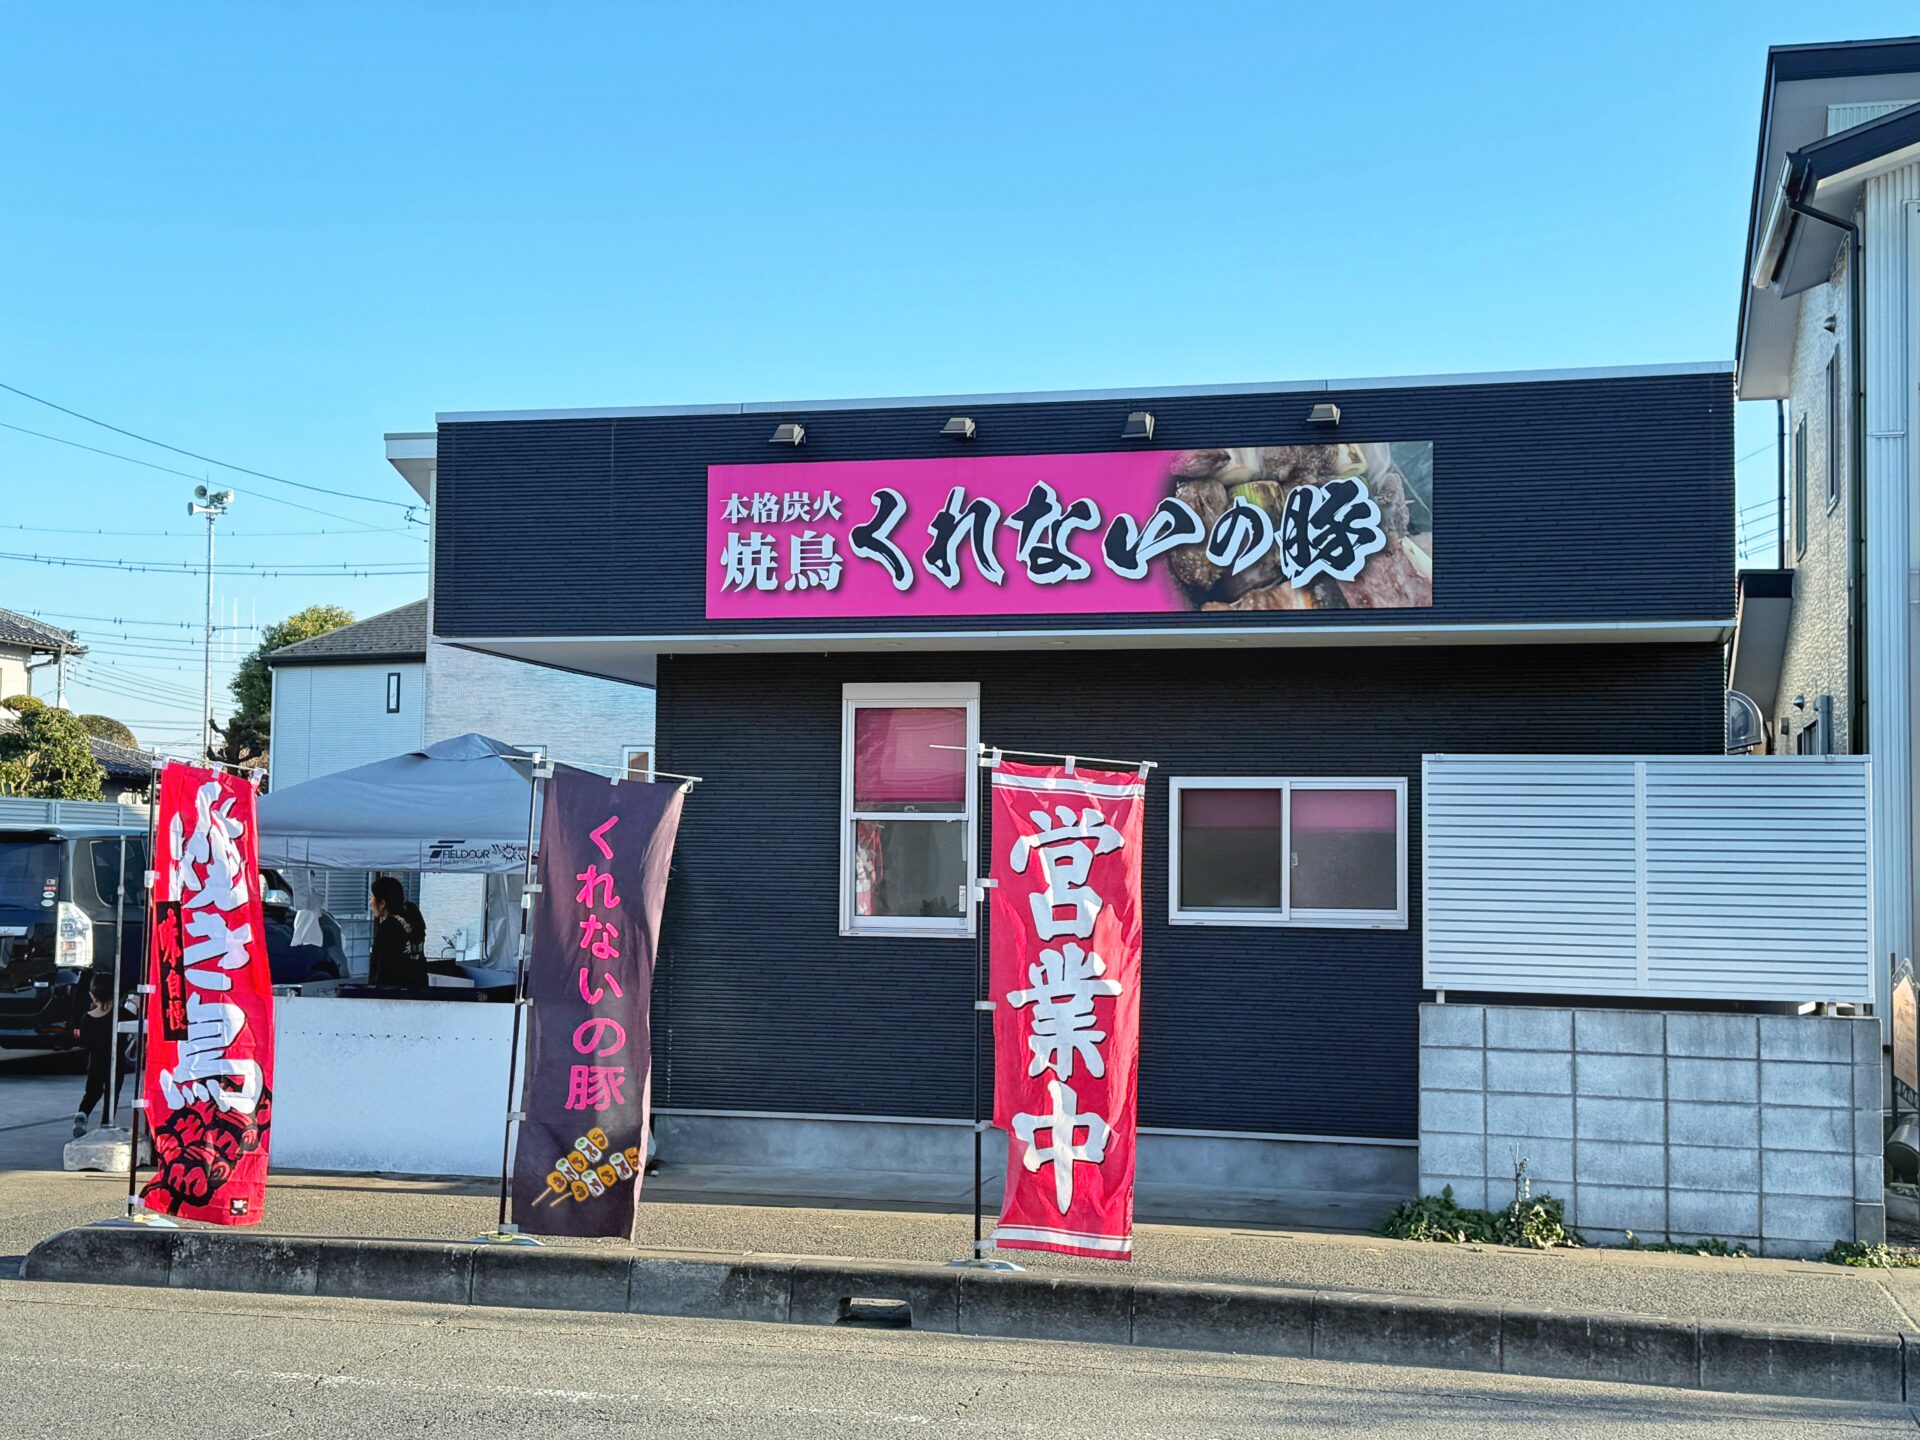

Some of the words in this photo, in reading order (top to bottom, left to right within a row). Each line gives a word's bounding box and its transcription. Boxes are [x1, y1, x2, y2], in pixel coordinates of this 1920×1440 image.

[720, 490, 842, 524] 本格炭火
[720, 530, 843, 592] 焼鳥
[849, 476, 1387, 591] くれないの豚
[158, 907, 187, 1031] 味自慢
[564, 815, 626, 1111] くれないの豚
[1006, 805, 1125, 1215] 営業中
